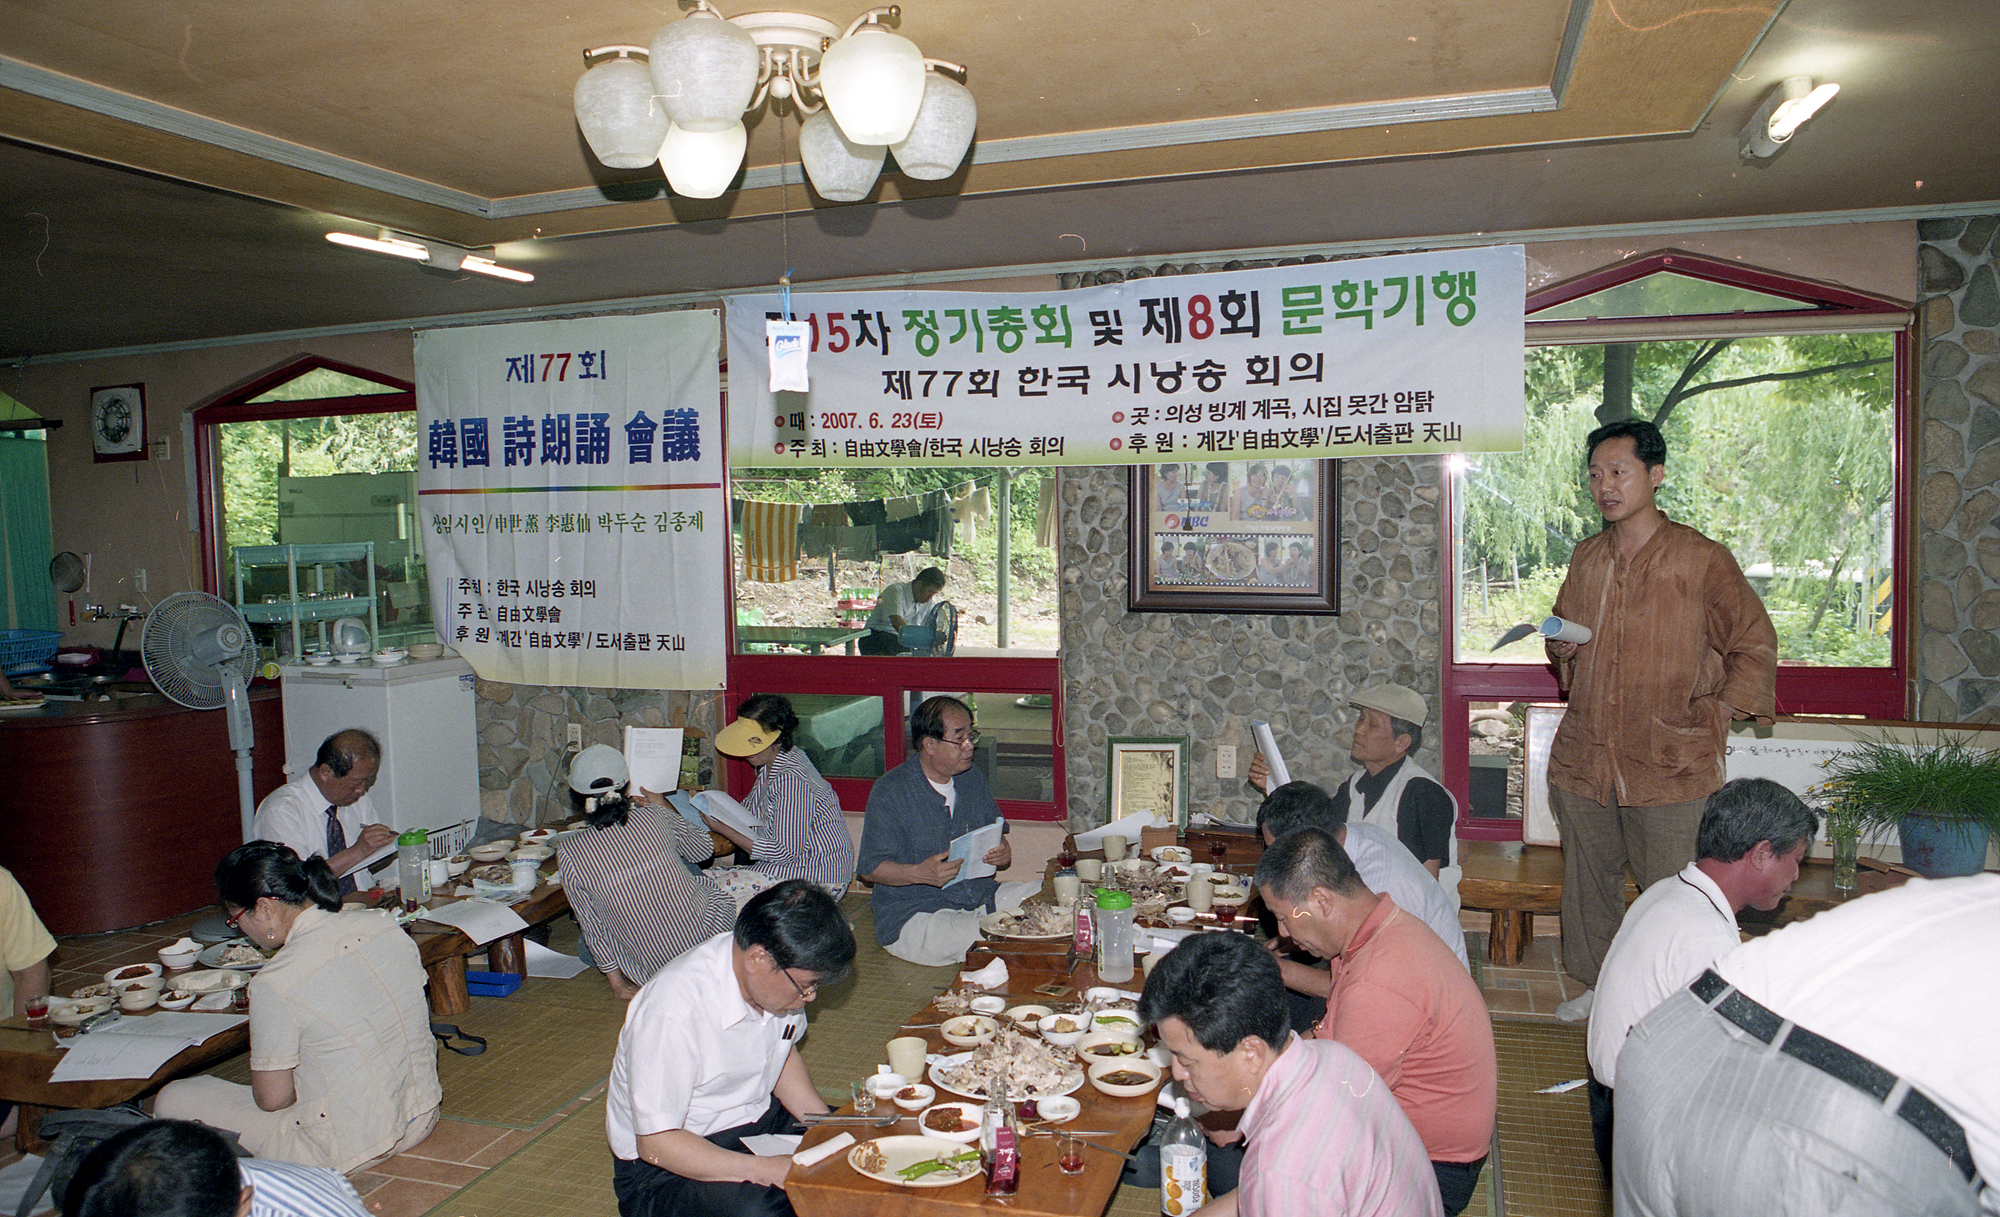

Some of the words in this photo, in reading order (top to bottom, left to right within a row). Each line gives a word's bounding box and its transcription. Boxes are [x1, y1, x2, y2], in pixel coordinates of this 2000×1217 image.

[766, 309, 892, 355] 15차
[903, 304, 1073, 356] 정기총회
[1089, 309, 1123, 346] 및
[1140, 290, 1260, 344] 제8회
[1281, 270, 1477, 336] 문학기행
[506, 349, 606, 383] 제77회
[882, 369, 999, 400] 제77회
[1018, 365, 1091, 396] 한국
[1107, 359, 1227, 395] 시낭송
[1245, 353, 1324, 387] 회의
[1131, 407, 1149, 426] 곳
[1165, 404, 1202, 423] 의성
[1209, 400, 1247, 422] 빙계
[1252, 398, 1297, 420] 계곡,
[1302, 396, 1342, 418] 시집
[1348, 393, 1388, 415] 못간
[1394, 390, 1434, 413] 암탉
[790, 412, 805, 431] 때
[821, 412, 862, 429] 2007.
[869, 412, 883, 429] 6.
[891, 412, 943, 430] 23(토)
[1423, 421, 1462, 442] 天山
[428, 417, 490, 469] 韓國
[503, 412, 610, 468] 詩朗誦
[624, 408, 701, 464] 會議
[845, 438, 962, 458] 自由文學會/한국
[969, 437, 1022, 457] 시낭송
[1029, 436, 1065, 457] 회의
[545, 513, 591, 533] 李惠仙
[599, 512, 647, 534] 박두순
[654, 510, 704, 533] 김종제
[497, 579, 520, 597] 한국
[526, 579, 565, 598] 시낭송
[570, 580, 596, 598] 회의
[497, 605, 561, 623] 自由文學會
[596, 632, 651, 651] 도서출판
[657, 634, 685, 651] 天山
